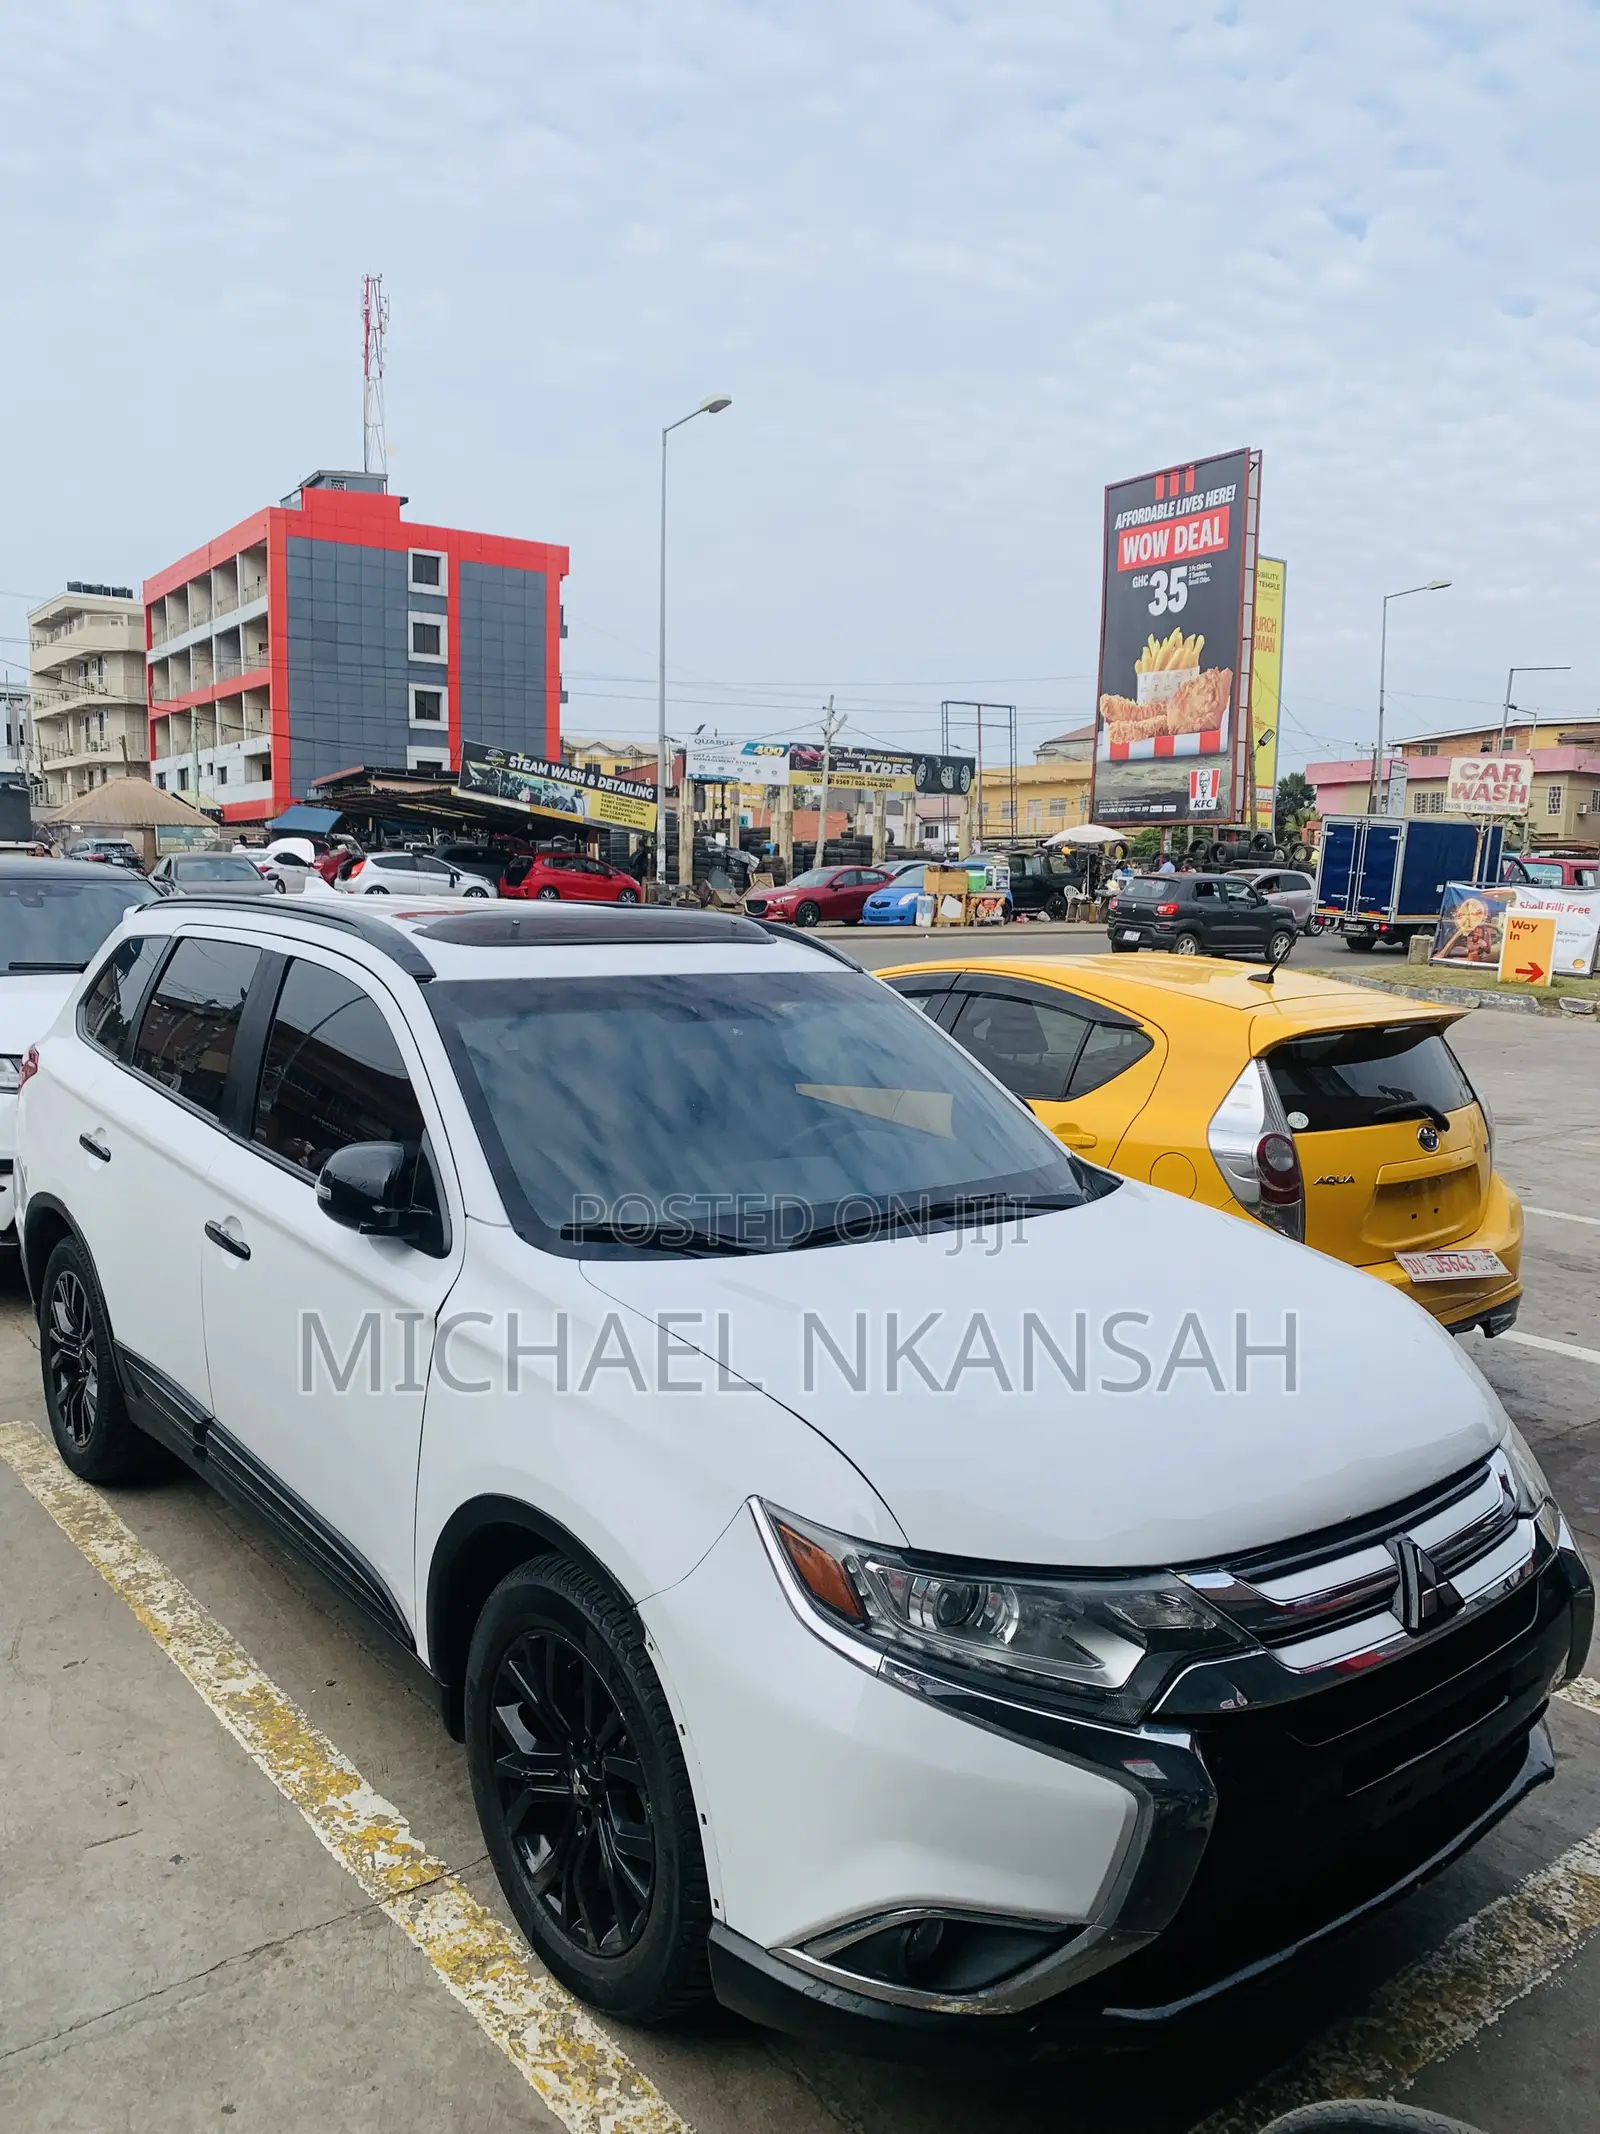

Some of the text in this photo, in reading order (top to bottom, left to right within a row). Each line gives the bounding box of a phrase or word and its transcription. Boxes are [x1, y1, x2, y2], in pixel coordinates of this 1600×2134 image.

[1115, 484, 1237, 530] AFFORDABLE LIVES HERE!
[1123, 517, 1224, 564] WOW DEAL
[1132, 566, 1188, 616] GHC 35
[1259, 581, 1281, 590] TEMPLE
[754, 745, 785, 757] 400
[859, 760, 913, 777] TYRES
[1460, 762, 1522, 782] CAR
[508, 755, 549, 776] STEAM
[551, 765, 586, 784] WASH
[587, 774, 596, 786] &
[597, 776, 654, 799] DETAILING
[1451, 782, 1527, 803] WASH
[1194, 800, 1213, 808] KFC
[1567, 904, 1591, 914] Free
[1512, 920, 1538, 933] Way
[1509, 932, 1520, 940] In
[1313, 1175, 1356, 1186] AQUA
